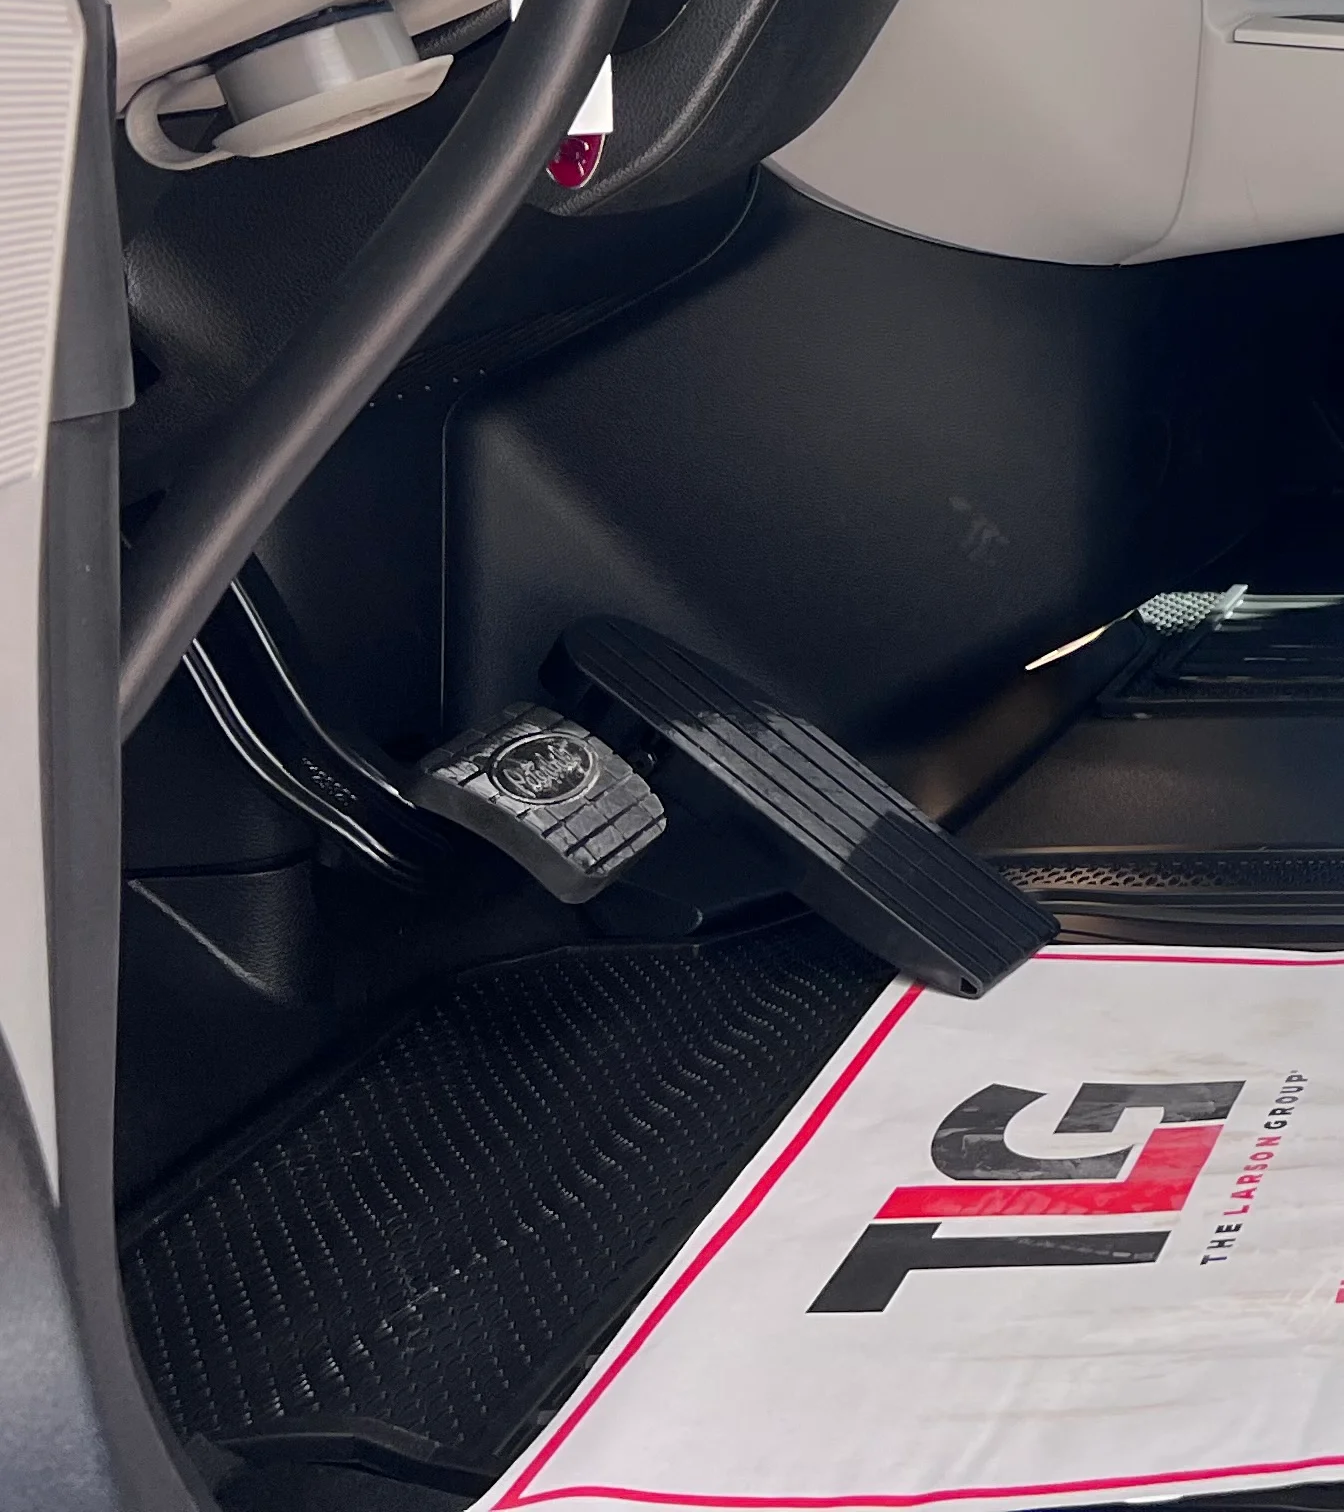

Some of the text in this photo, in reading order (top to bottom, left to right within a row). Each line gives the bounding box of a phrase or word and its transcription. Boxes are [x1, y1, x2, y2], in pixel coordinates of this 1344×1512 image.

[806, 1079, 1247, 1313] TLG
[1199, 1073, 1308, 1266] THE LARSON GROUP
